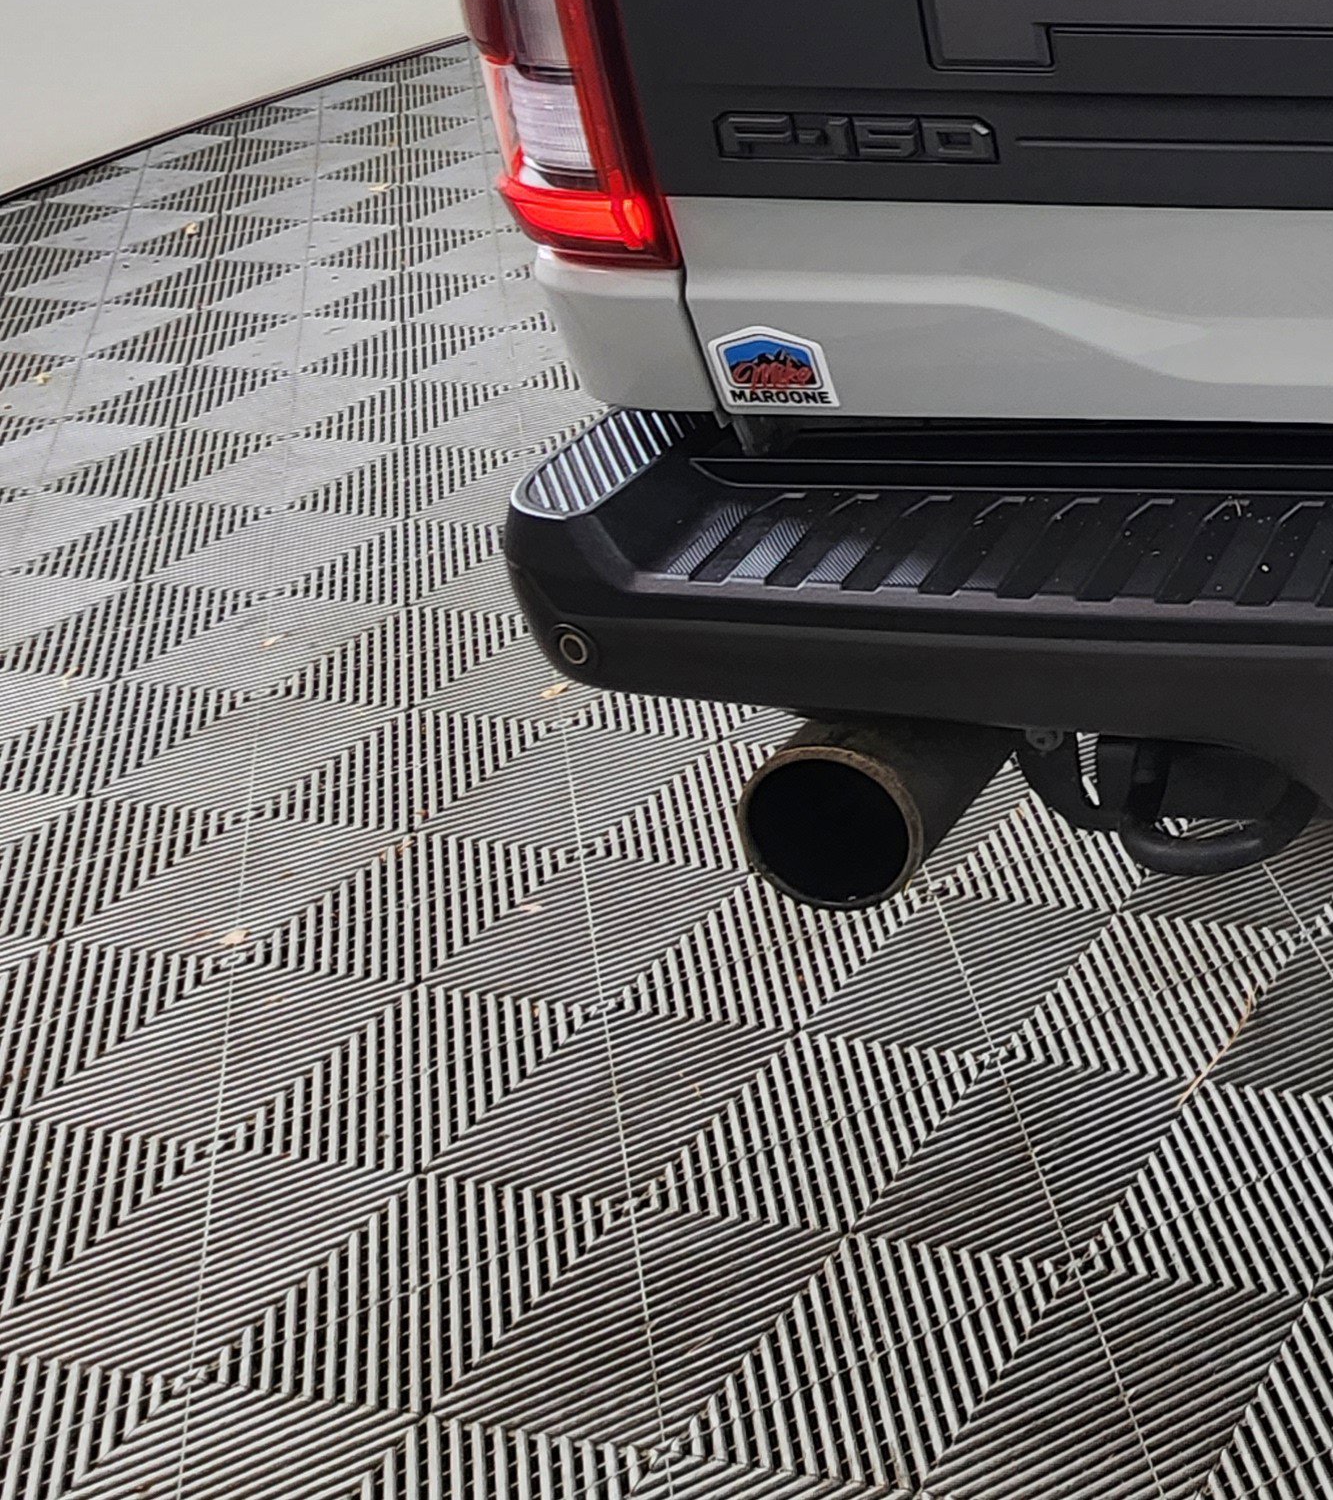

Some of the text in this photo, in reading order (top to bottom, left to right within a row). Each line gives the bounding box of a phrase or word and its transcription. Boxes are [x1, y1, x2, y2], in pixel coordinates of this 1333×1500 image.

[714, 110, 1000, 164] F-150
[732, 361, 813, 391] Mike
[730, 390, 832, 404] MAROONE
